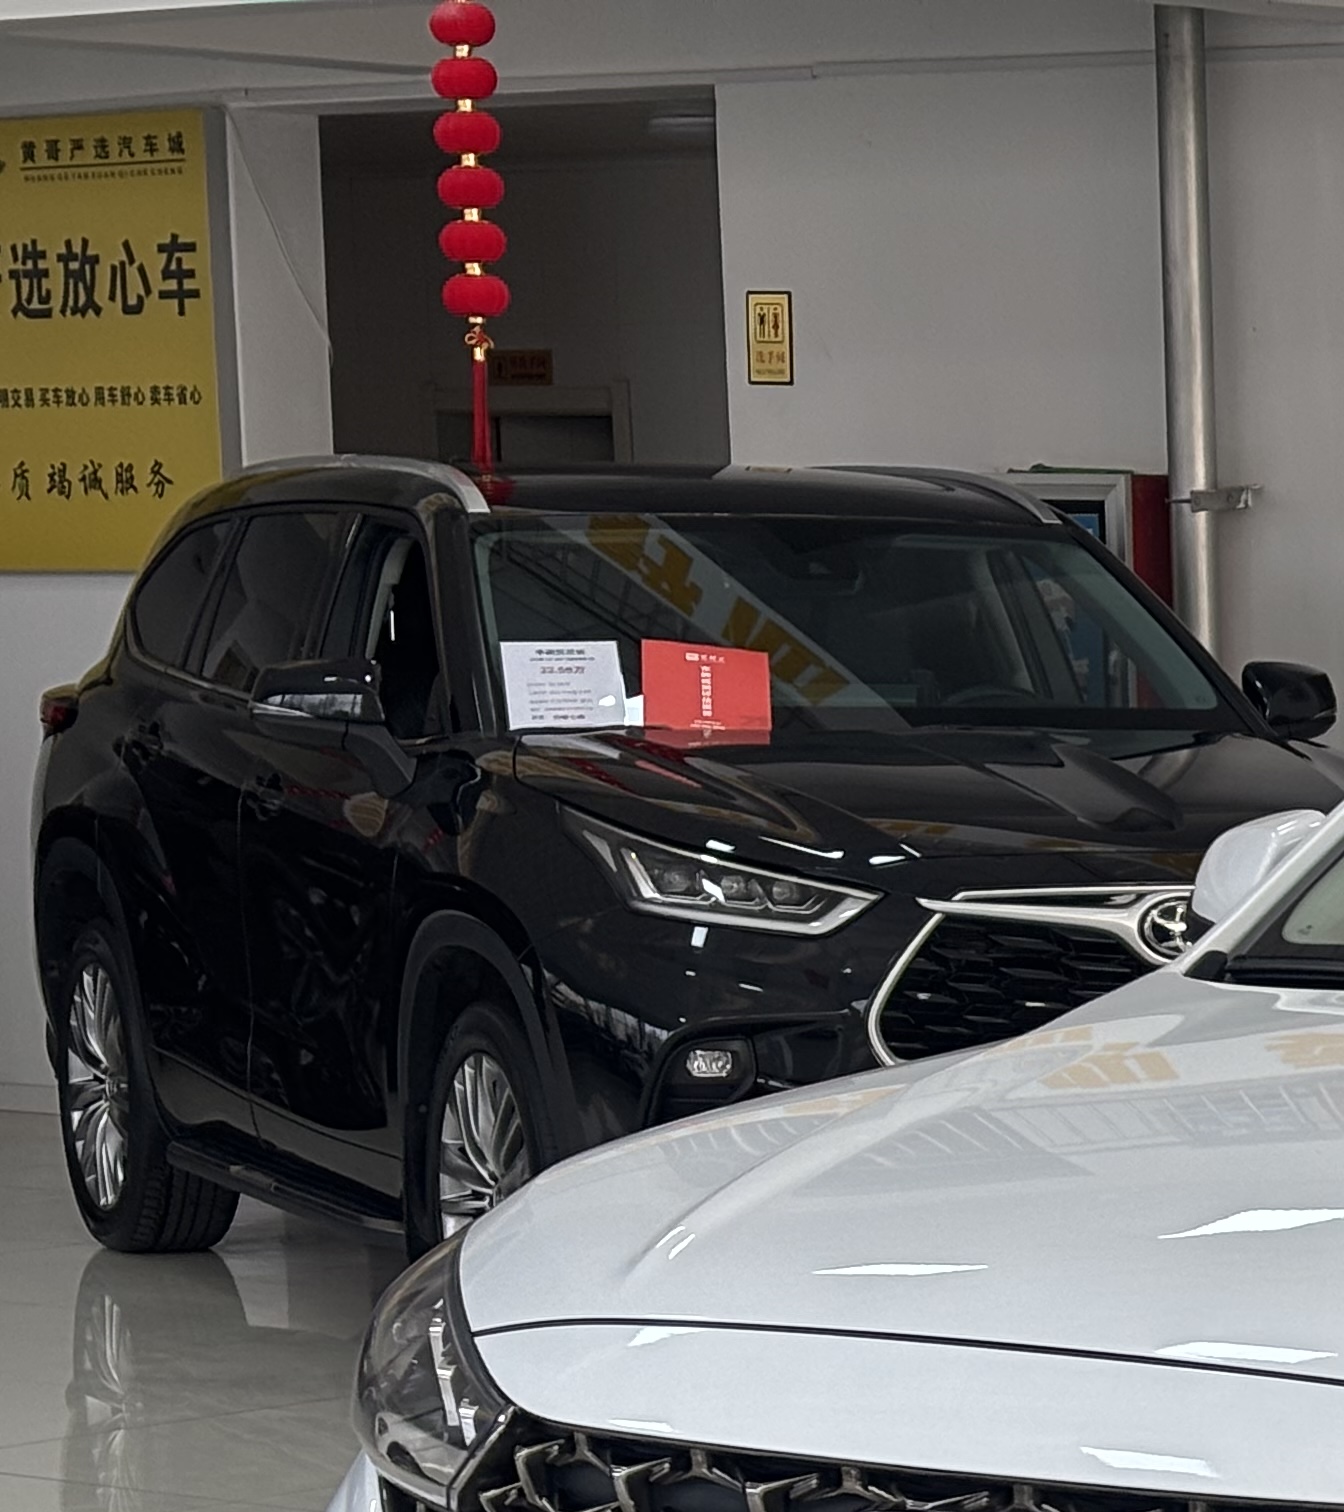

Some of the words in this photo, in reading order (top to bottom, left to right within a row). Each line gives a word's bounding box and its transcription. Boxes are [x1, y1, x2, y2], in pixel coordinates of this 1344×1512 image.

[20, 130, 186, 165] 黄哥严选汽车城
[8, 232, 201, 319] 选放心车
[47, 458, 174, 500] 竭诚服务
